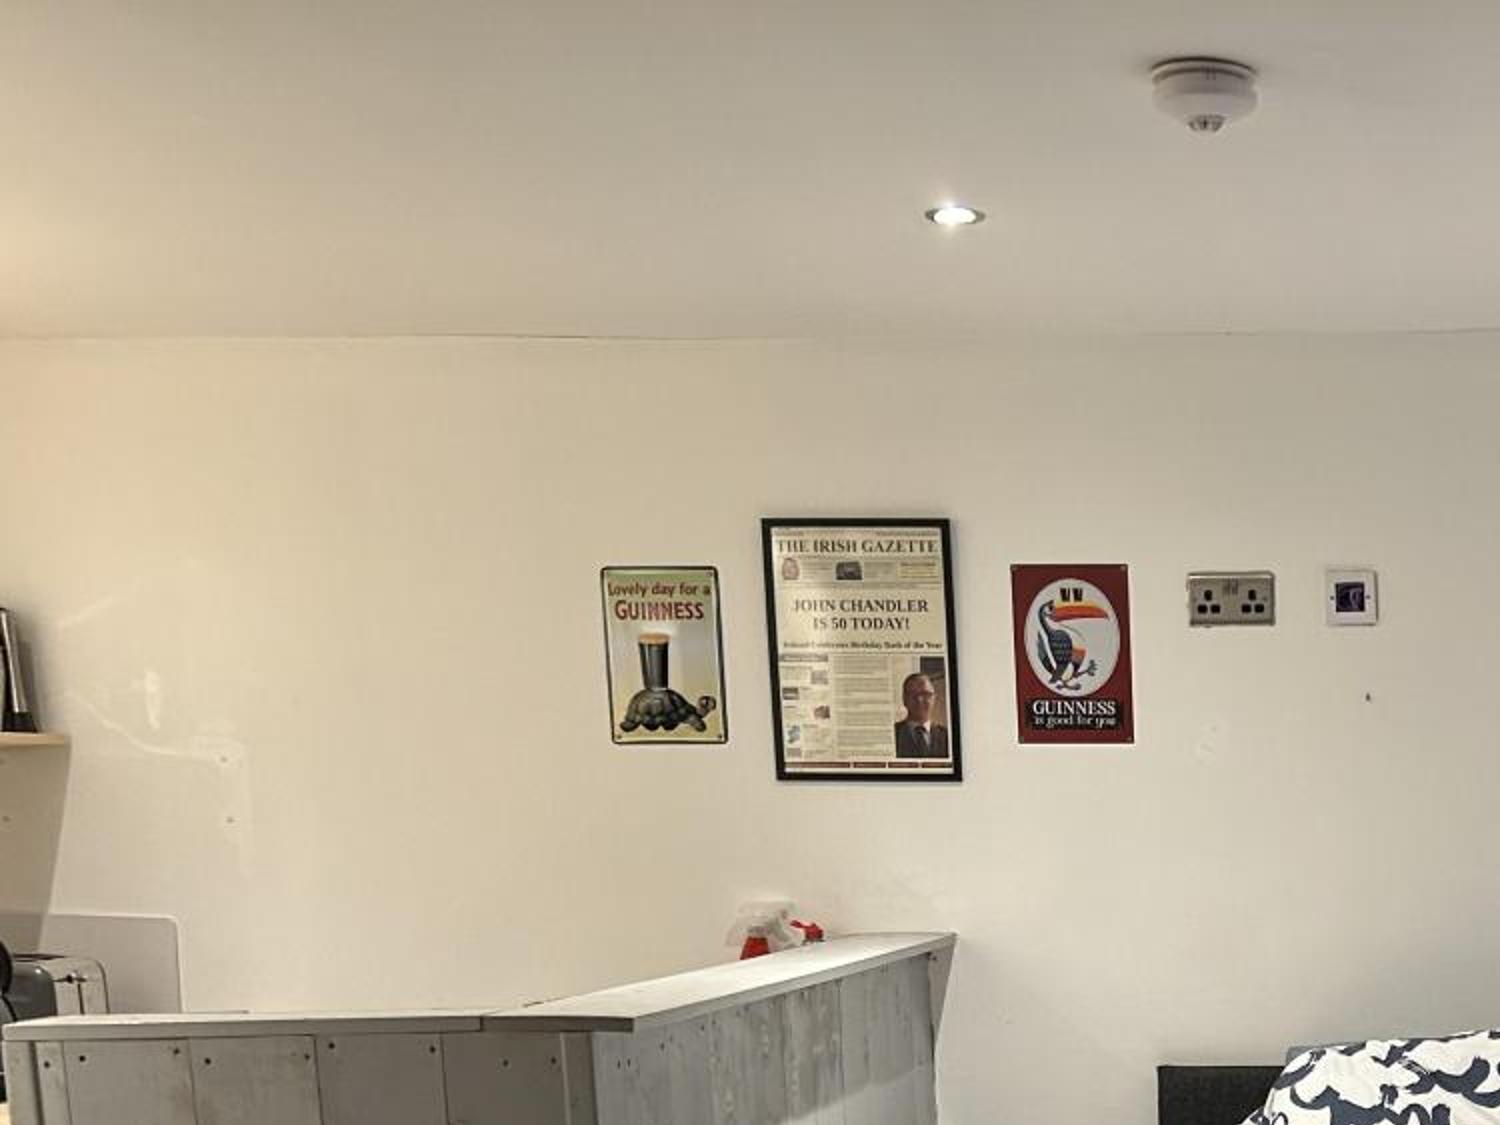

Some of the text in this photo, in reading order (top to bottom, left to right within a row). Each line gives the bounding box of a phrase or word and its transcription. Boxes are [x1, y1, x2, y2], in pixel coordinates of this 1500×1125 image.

[779, 539, 939, 553] THE IRISH GAZETTE
[607, 582, 711, 598] Lovely day for a
[615, 599, 705, 621] GUINNESS
[794, 599, 929, 613] JOHN CHANDLER
[813, 617, 911, 630] IS 50 TODAY!
[1033, 699, 1117, 716] GUINNESS
[1046, 715, 1073, 728] good
[1076, 714, 1094, 725] for
[1095, 715, 1117, 728] you
